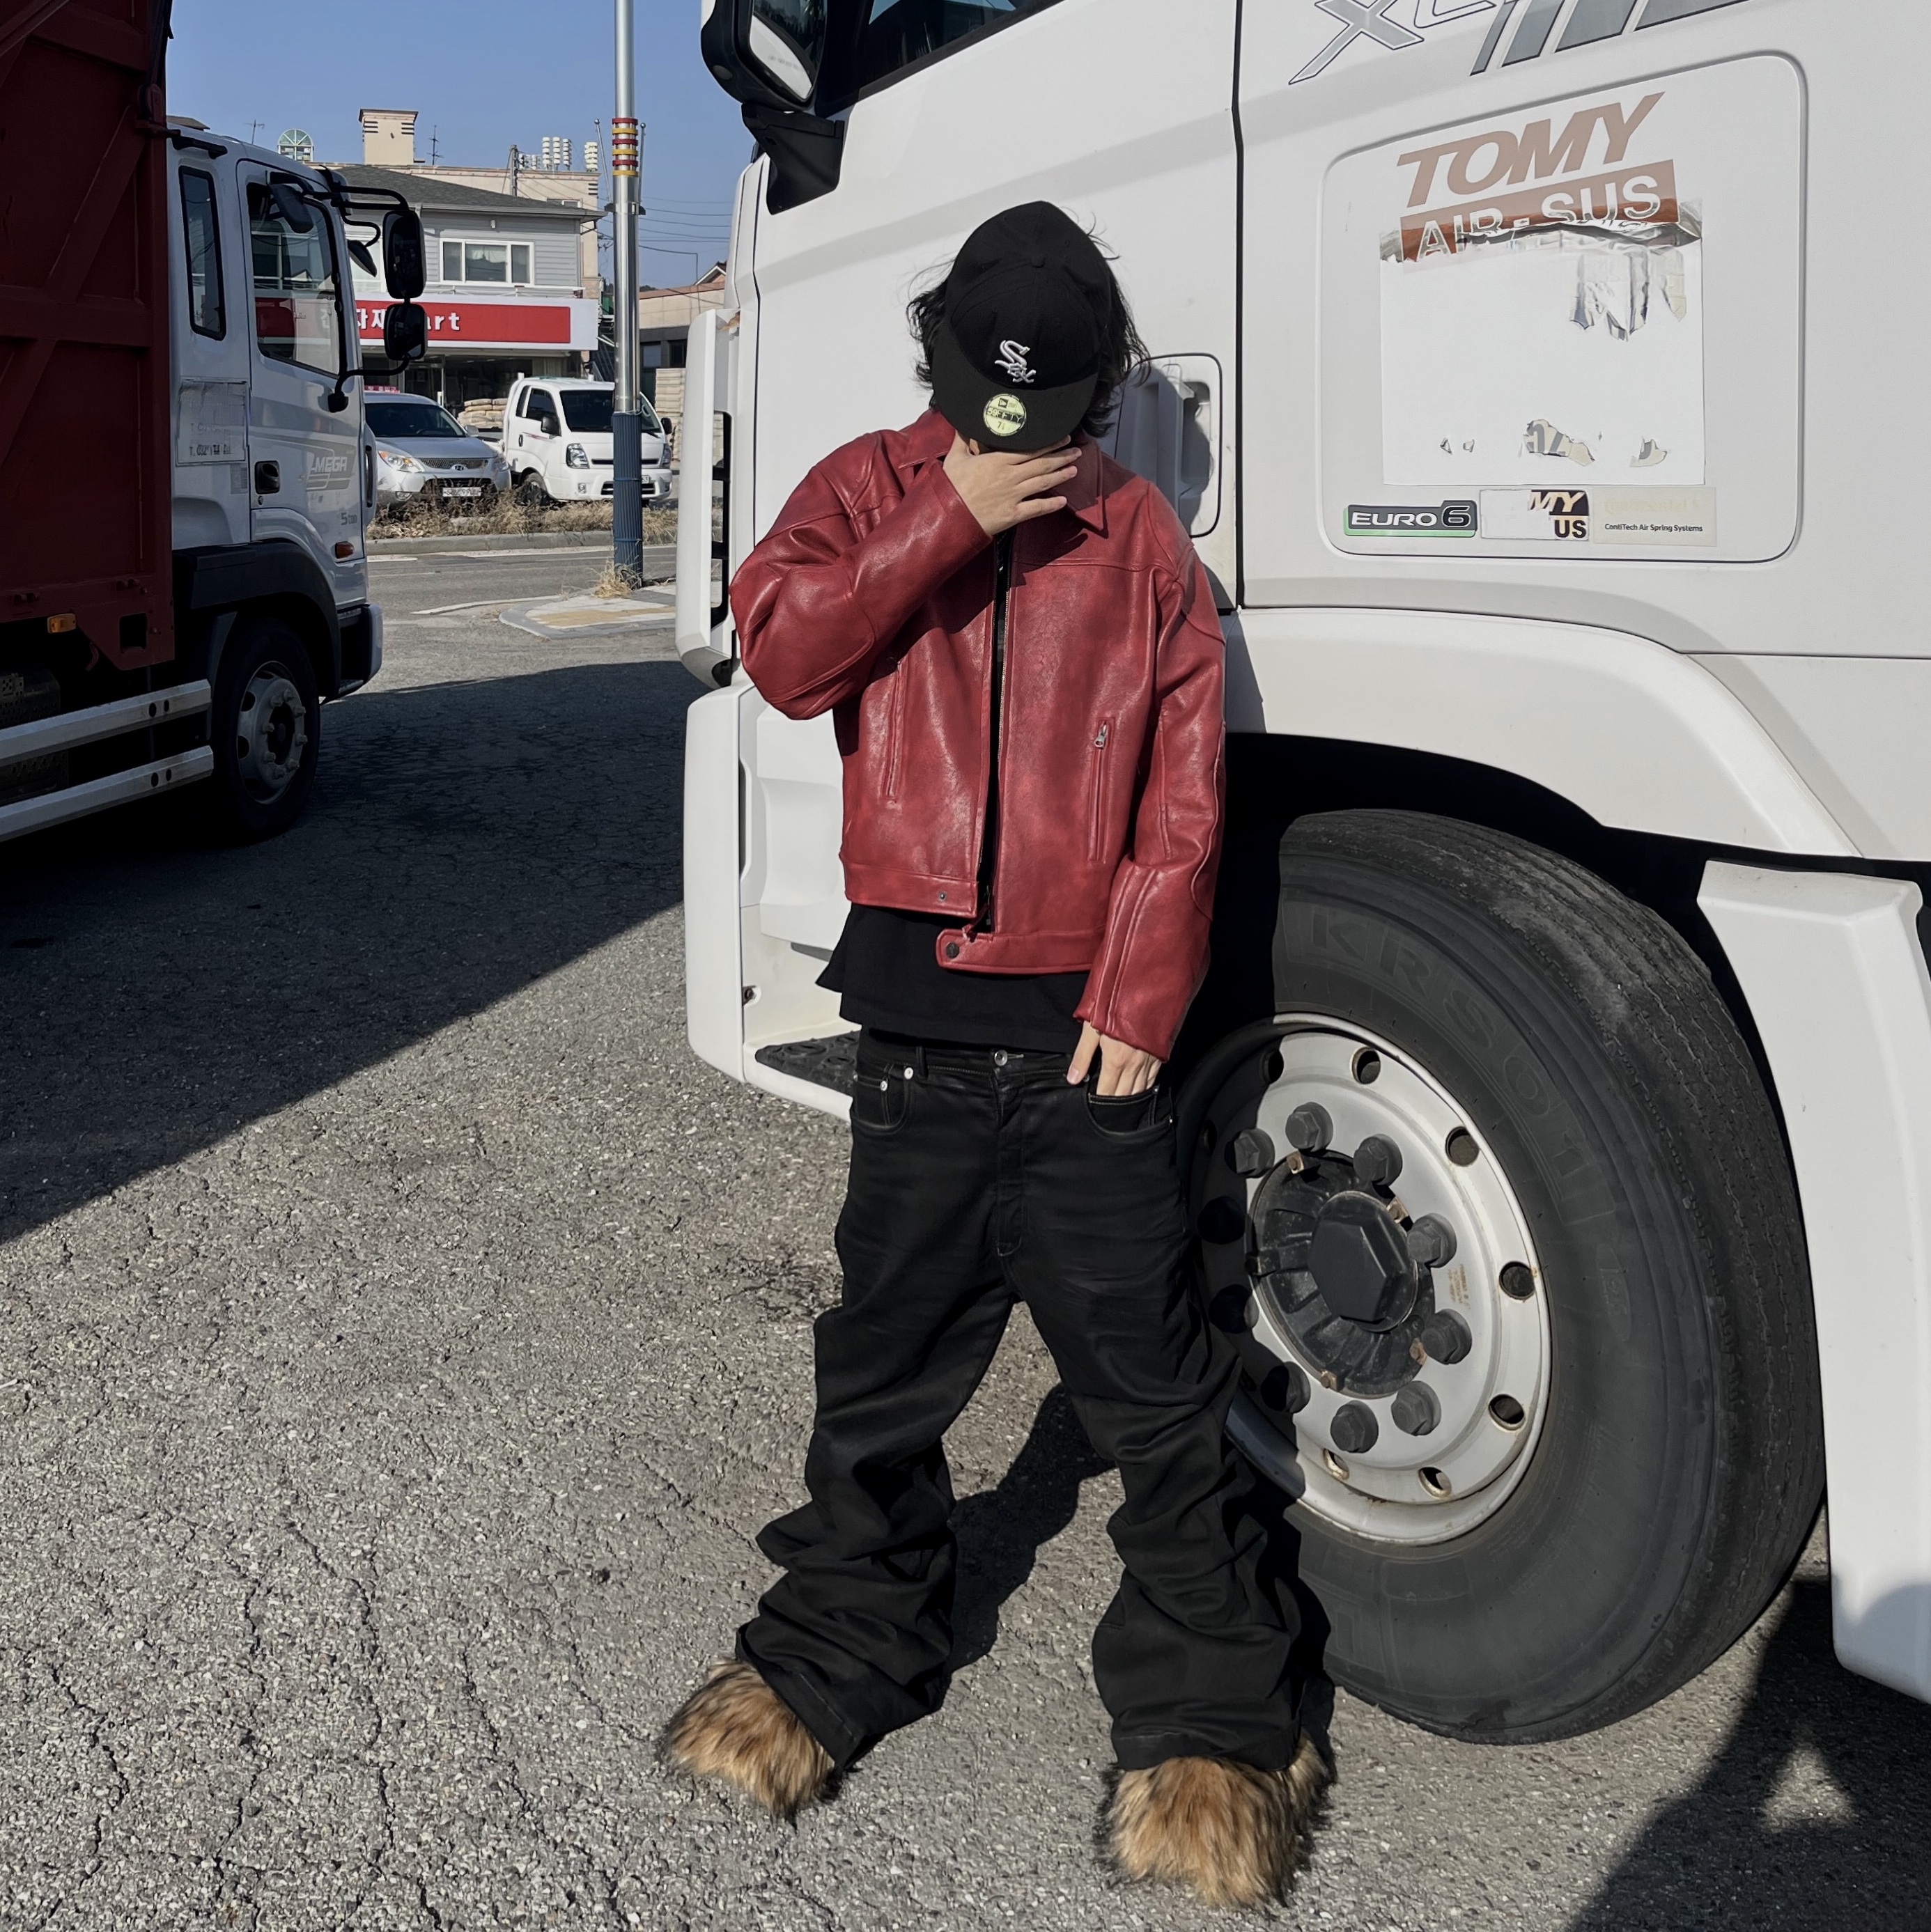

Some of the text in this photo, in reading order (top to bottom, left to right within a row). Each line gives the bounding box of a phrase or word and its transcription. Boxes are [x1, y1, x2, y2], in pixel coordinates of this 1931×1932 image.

[1397, 92, 1666, 208] TOMY
[315, 455, 348, 473] MEGA
[1554, 520, 1587, 538] US
[1650, 524, 1673, 533] Spring
[1673, 524, 1703, 533] Systems
